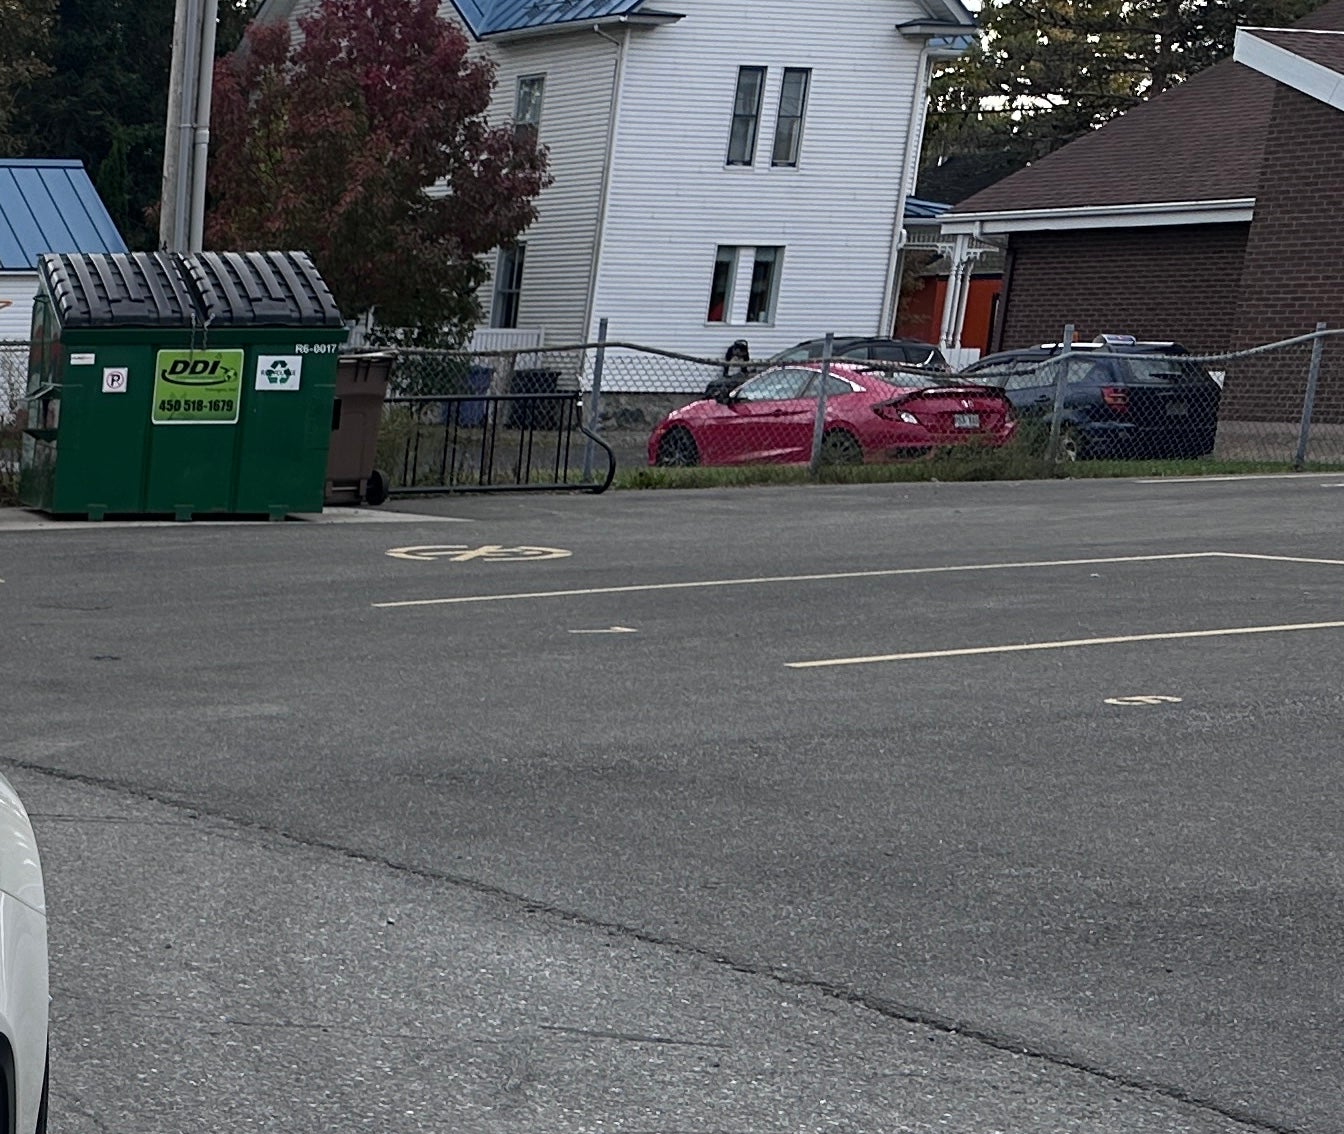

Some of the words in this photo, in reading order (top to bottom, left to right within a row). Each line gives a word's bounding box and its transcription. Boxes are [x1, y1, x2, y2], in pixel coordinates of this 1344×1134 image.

[295, 344, 337, 354] R6-0017
[167, 360, 221, 375] DDI
[158, 400, 181, 412] 450
[183, 399, 234, 412] 518-1679
